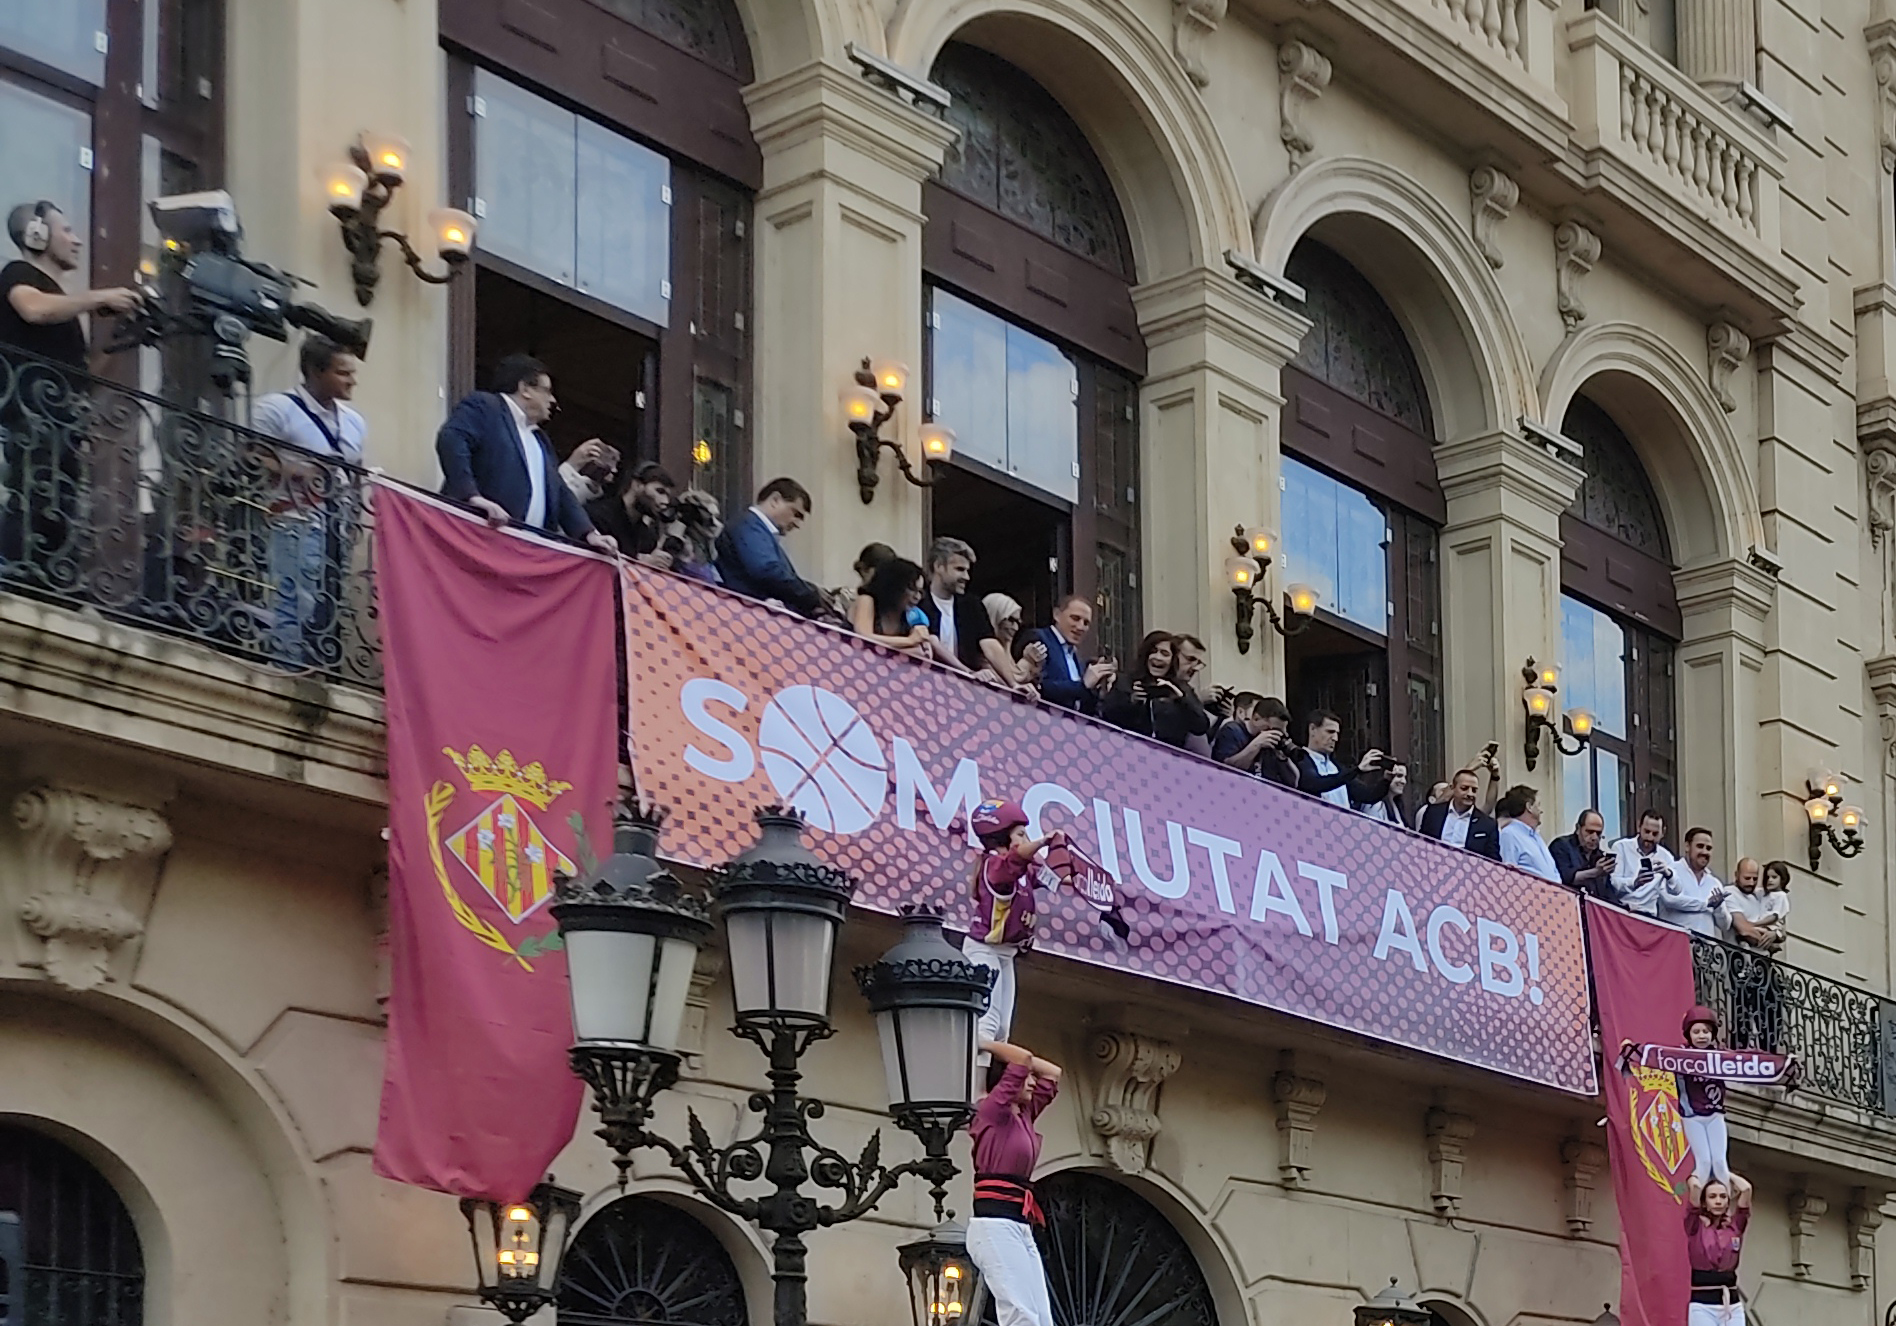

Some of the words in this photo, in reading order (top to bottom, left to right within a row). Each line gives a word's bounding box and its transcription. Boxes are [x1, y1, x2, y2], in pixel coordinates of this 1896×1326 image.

[1021, 781, 1348, 945] CIUTAT
[1373, 890, 1544, 1006] ACB!
[1657, 1048, 1775, 1077] forçalleida
